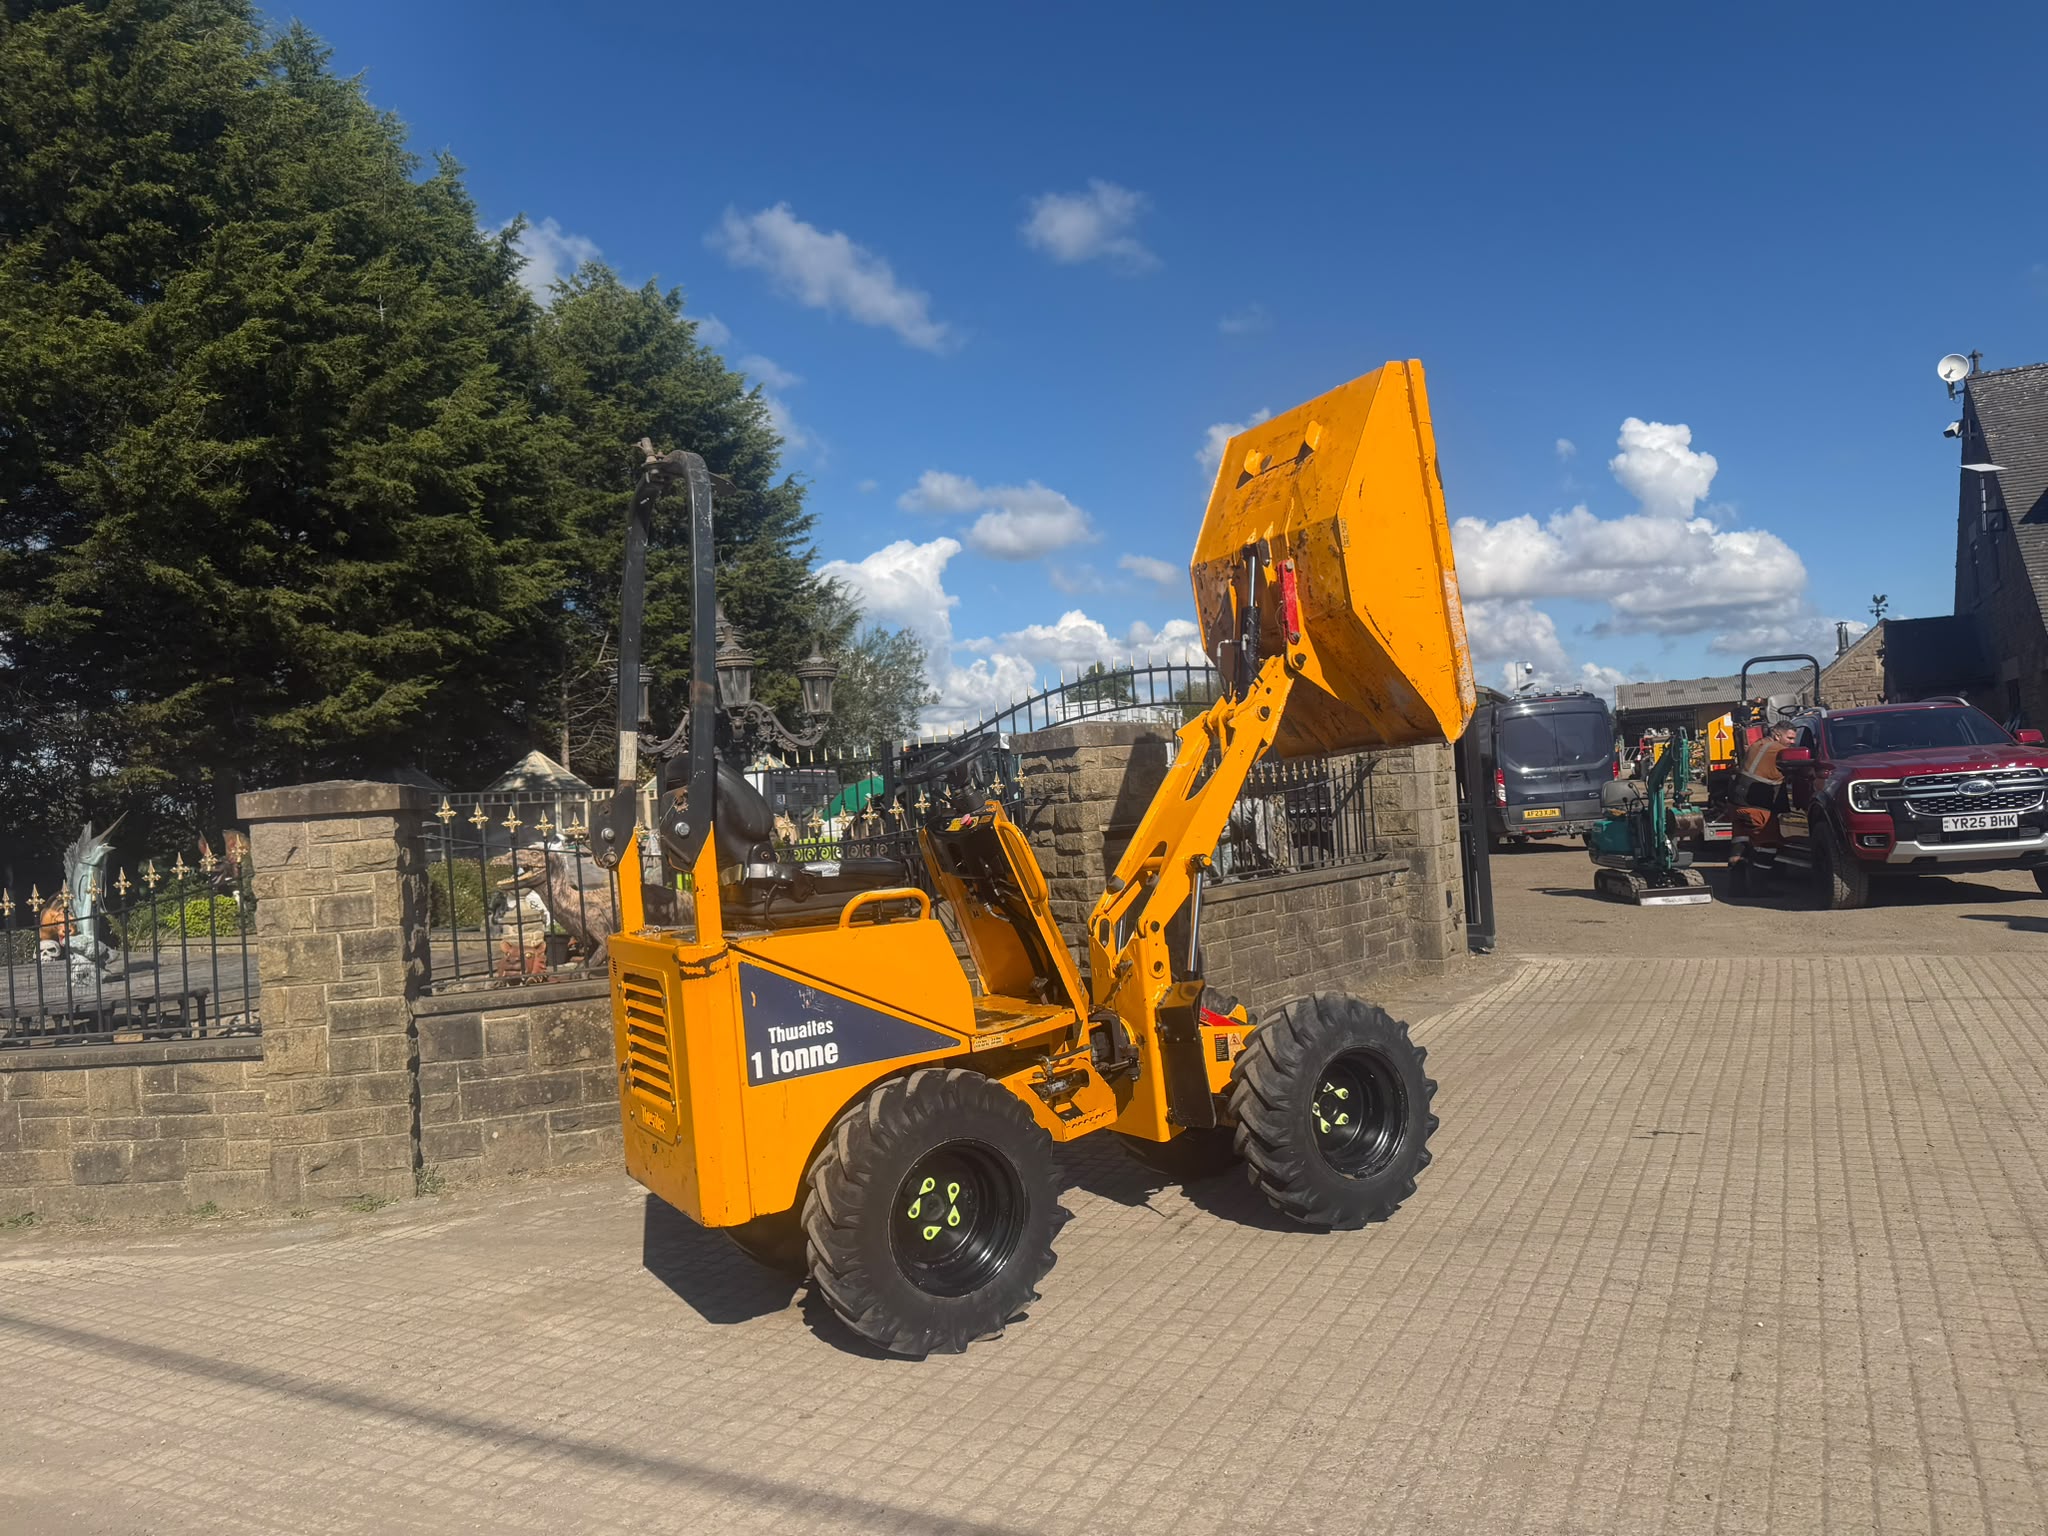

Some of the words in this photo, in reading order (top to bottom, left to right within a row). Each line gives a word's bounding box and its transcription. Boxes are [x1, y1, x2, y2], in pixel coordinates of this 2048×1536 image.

[1951, 817, 1986, 829] YR25
[1990, 815, 2016, 827] BHK
[768, 1020, 834, 1044] Thwaites
[751, 1051, 763, 1079] 1
[771, 1042, 839, 1075] tonne
